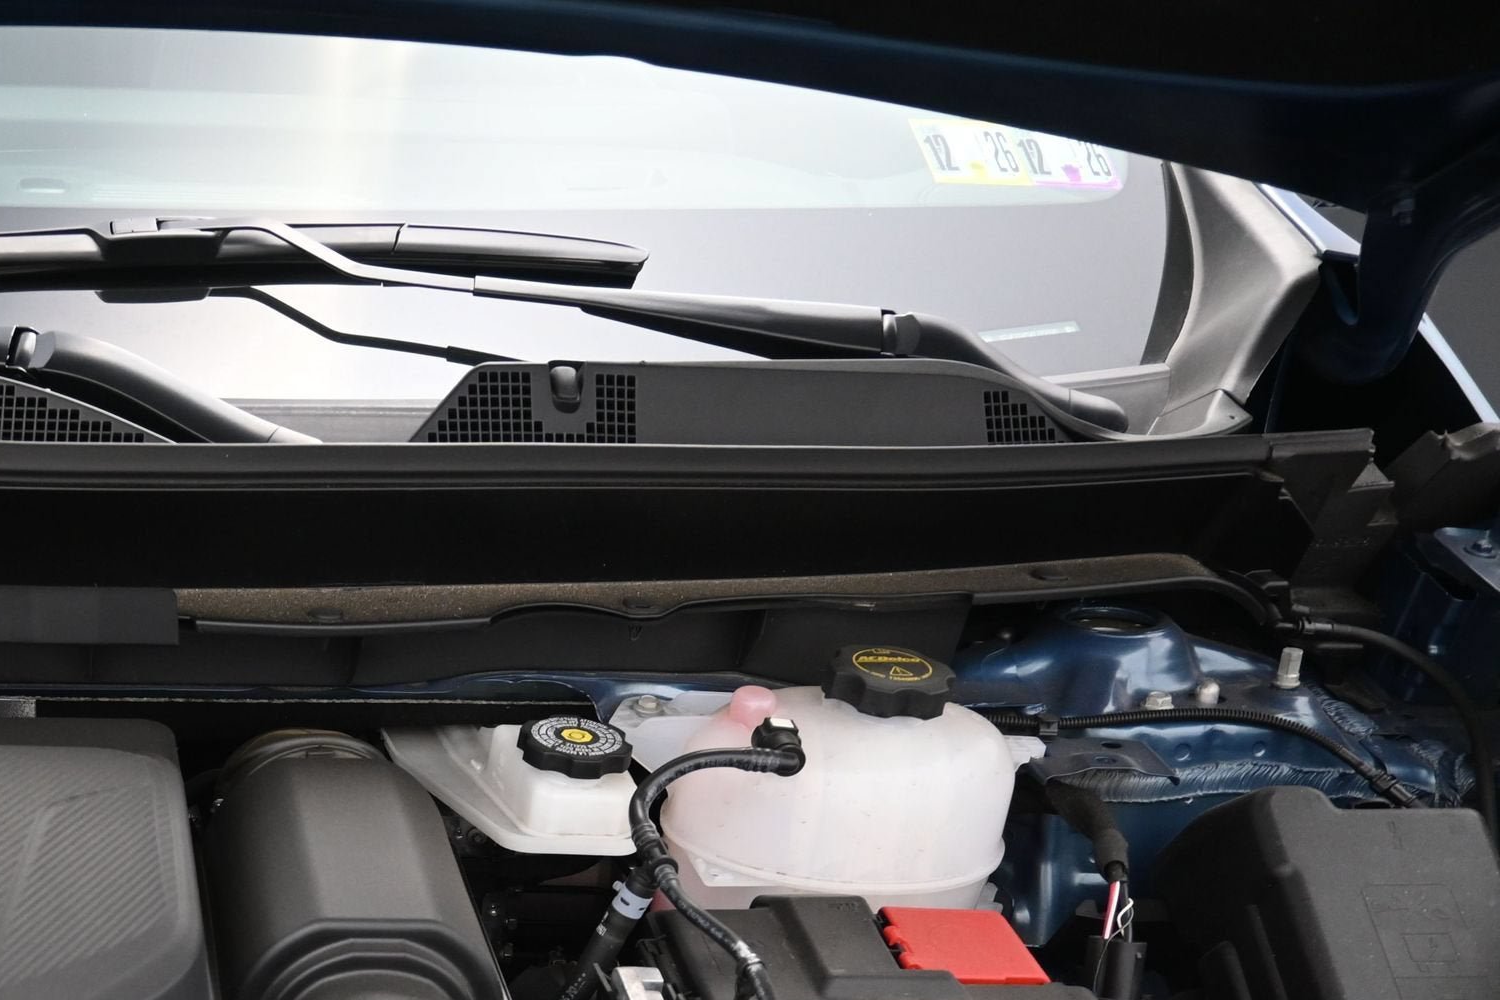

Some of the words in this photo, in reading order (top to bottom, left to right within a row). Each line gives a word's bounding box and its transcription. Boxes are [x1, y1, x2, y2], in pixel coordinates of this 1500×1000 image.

[924, 134, 960, 171] 12
[983, 131, 1020, 173] 26
[1017, 138, 1053, 176] 12
[1078, 140, 1112, 177] 26
